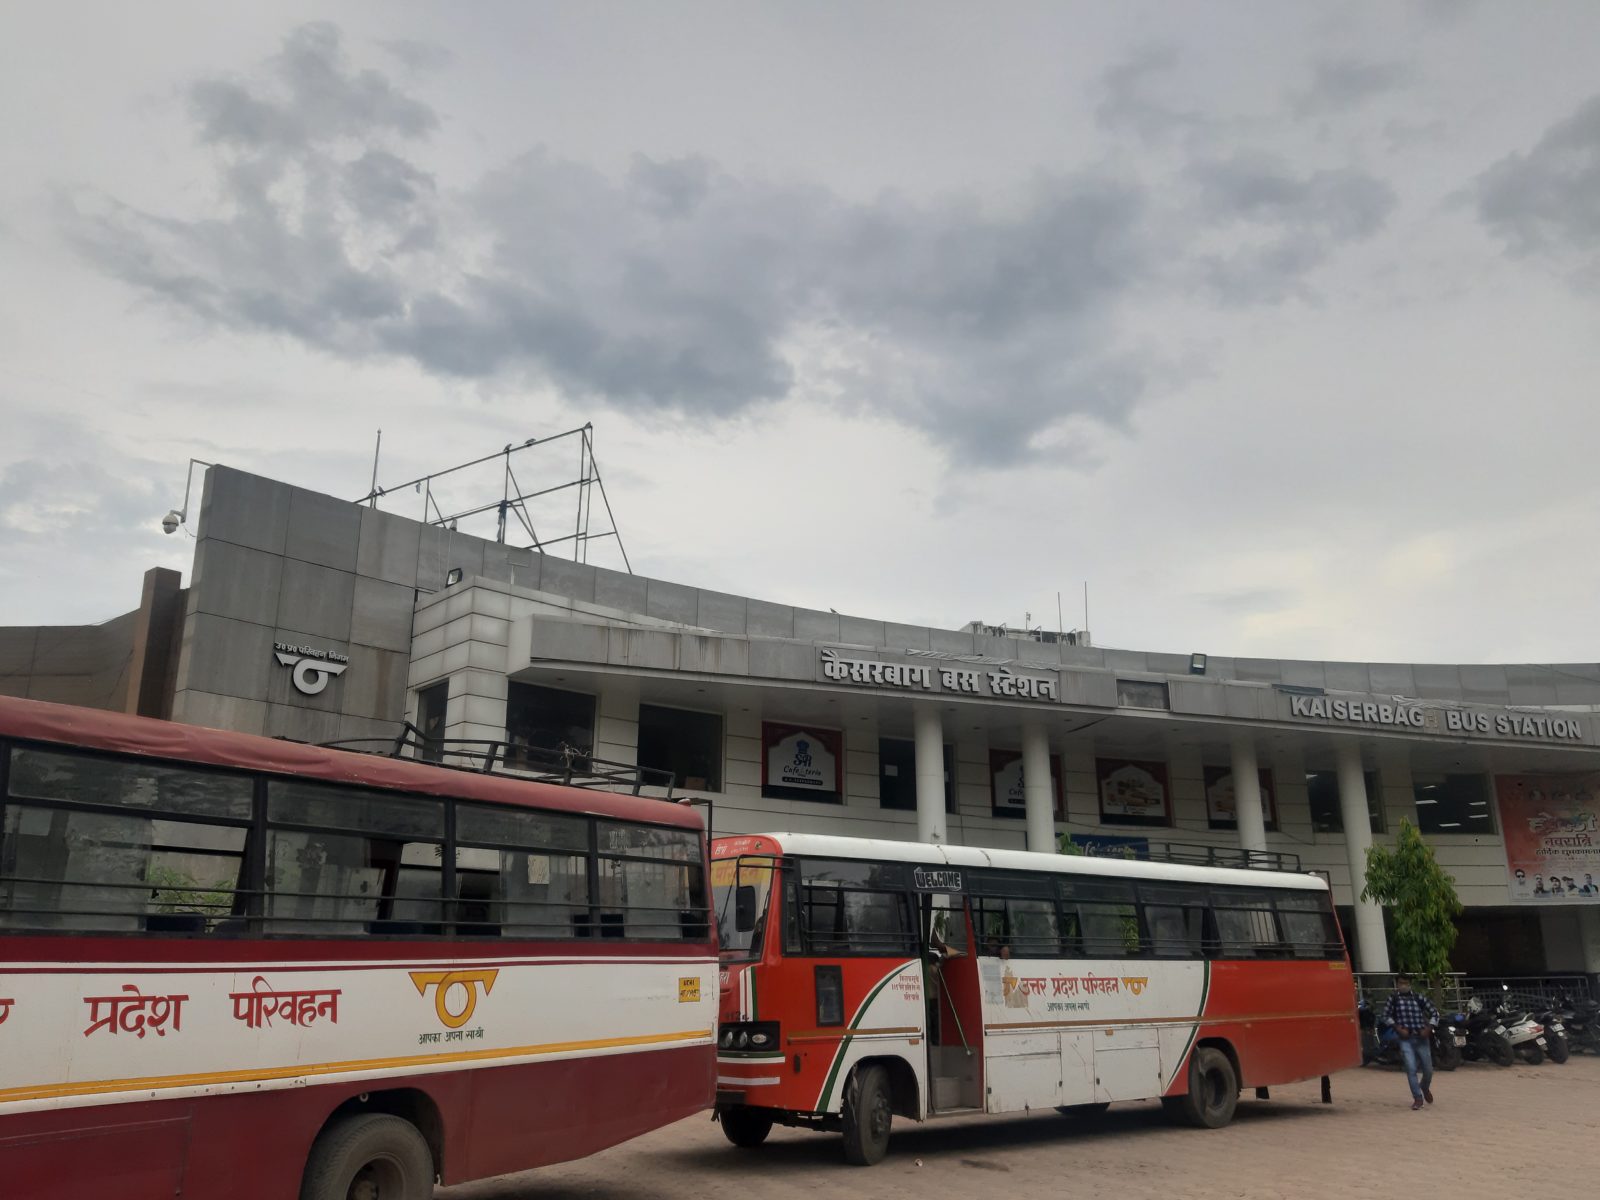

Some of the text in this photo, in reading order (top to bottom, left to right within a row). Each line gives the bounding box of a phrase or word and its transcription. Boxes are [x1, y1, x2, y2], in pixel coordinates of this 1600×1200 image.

[821, 649, 1058, 700] कैसरबाग बस स्टेशन
[1446, 710, 1491, 733] BUS
[1495, 713, 1582, 740] STATION
[914, 867, 961, 890] WELCOME
[1018, 972, 1119, 998] उत्तर प्रदेश परिवहन
[83, 975, 342, 1039] प्रदेश परिवहन
[419, 1026, 484, 1044] आपका अपना साथी
